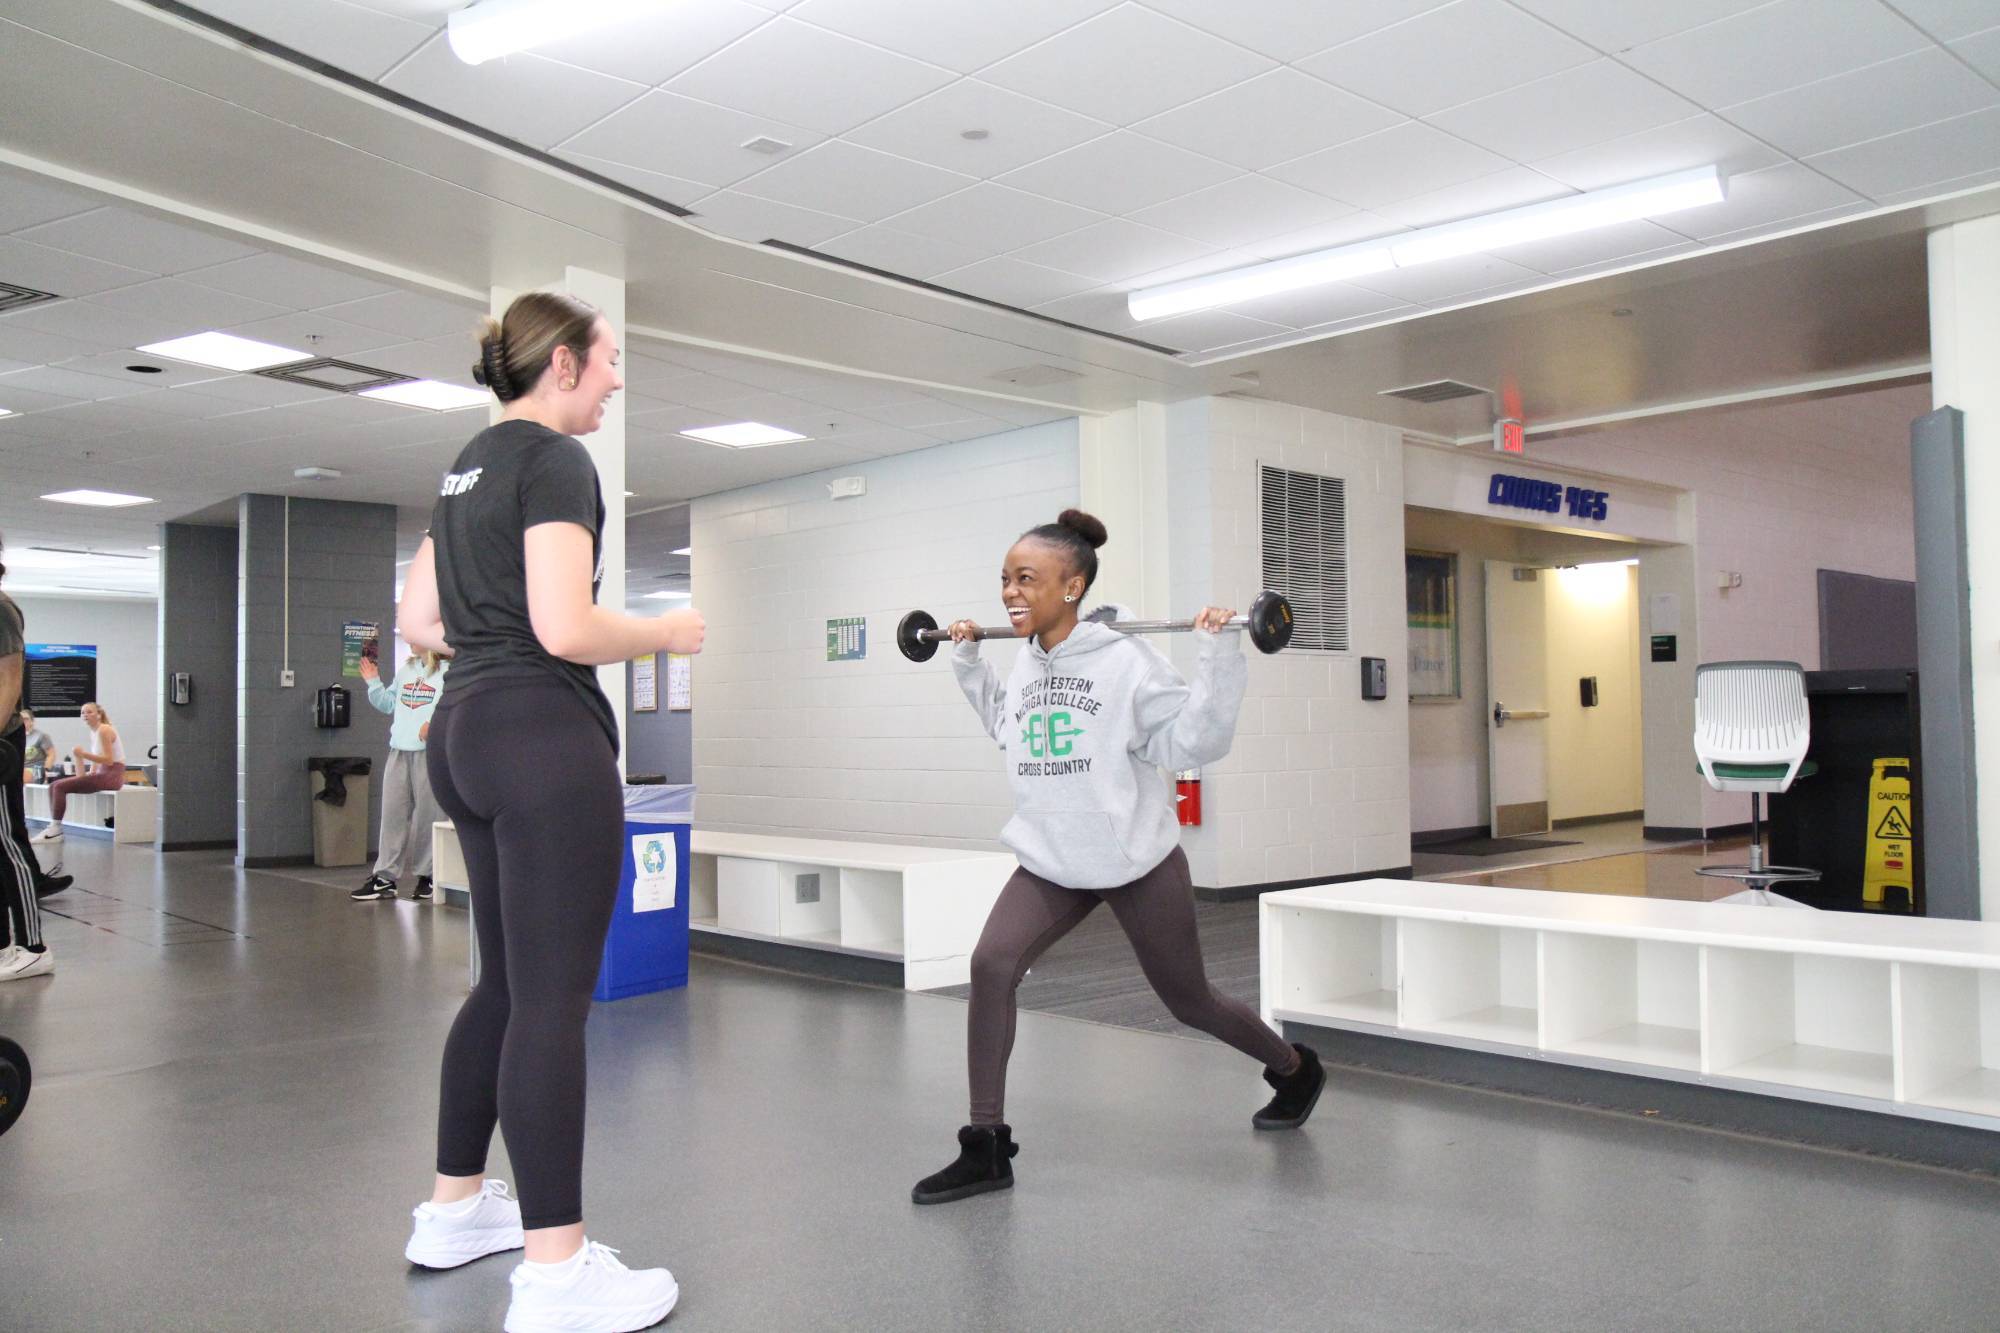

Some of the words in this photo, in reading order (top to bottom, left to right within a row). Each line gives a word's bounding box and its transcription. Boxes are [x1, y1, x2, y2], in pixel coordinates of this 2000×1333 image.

[1503, 423, 1523, 452] EXIT
[1488, 473, 1562, 513] COURTS
[1050, 692, 1102, 716] COLLEGE
[1018, 762, 1042, 776] CROSS
[1044, 758, 1092, 776] COUNTRY
